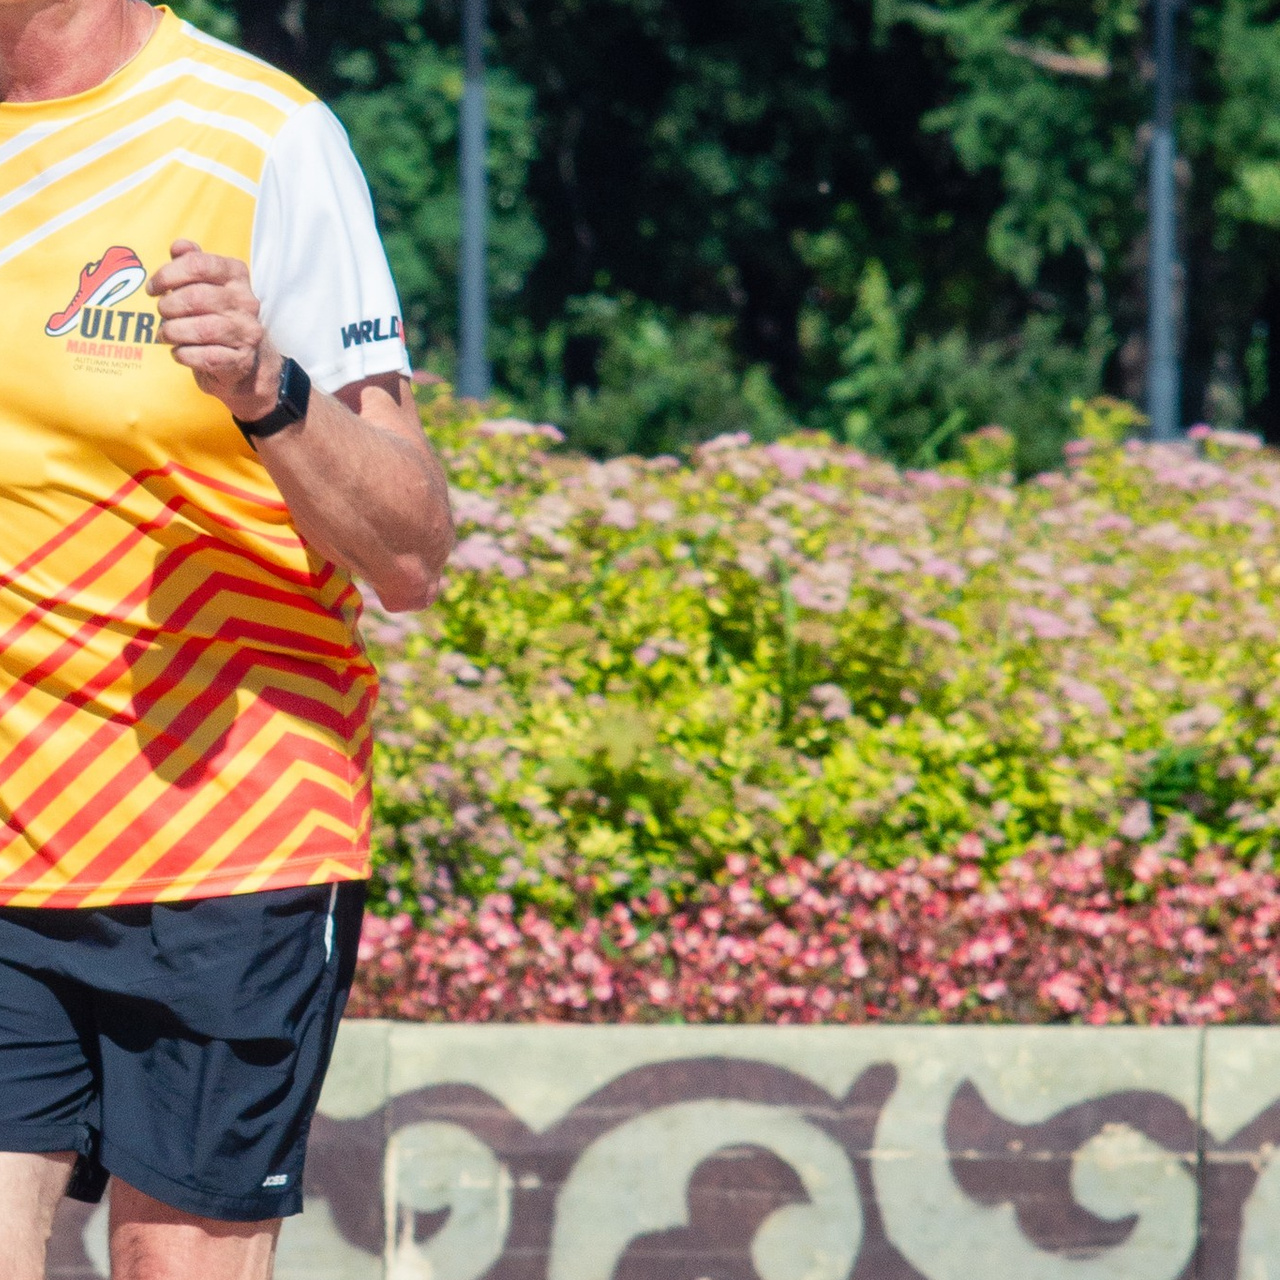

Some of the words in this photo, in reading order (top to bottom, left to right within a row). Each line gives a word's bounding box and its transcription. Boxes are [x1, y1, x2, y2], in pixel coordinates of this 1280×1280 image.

[66, 339, 143, 361] MARATHON
[74, 357, 110, 368] AUTUMN
[111, 361, 142, 370] MONTH
[86, 366, 122, 376] RUNNING
